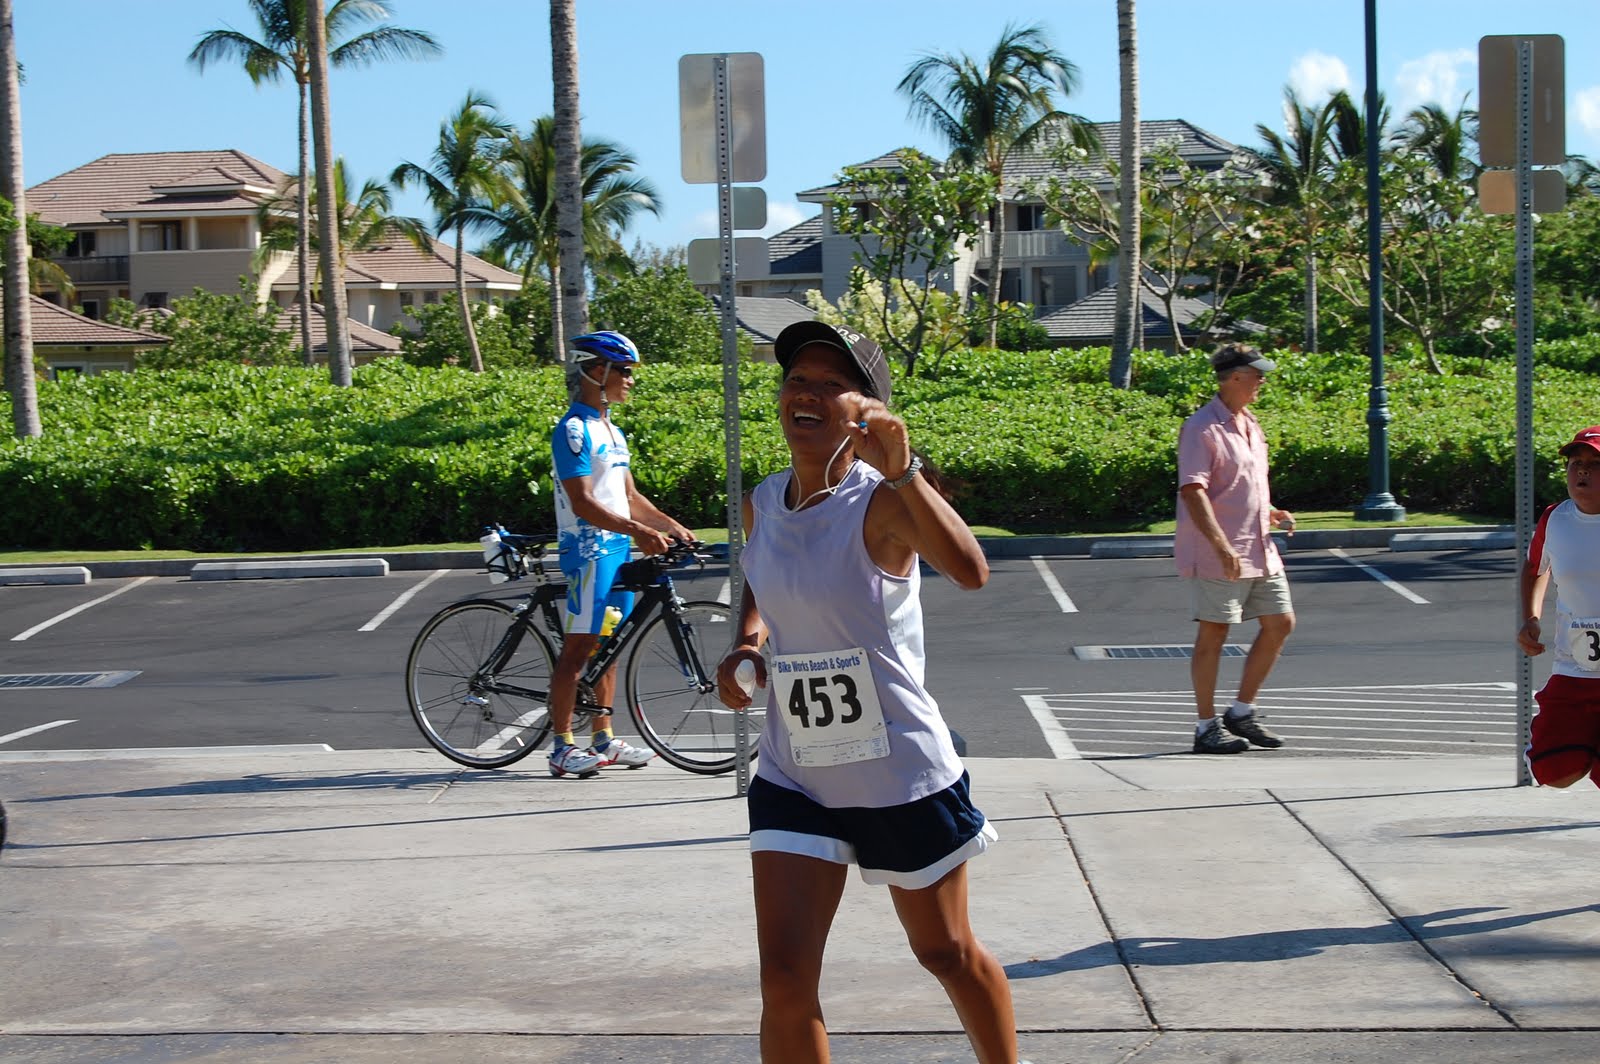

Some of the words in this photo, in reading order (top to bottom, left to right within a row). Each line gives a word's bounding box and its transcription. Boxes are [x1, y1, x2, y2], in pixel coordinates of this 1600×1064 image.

[778, 661, 792, 673] Bike
[791, 661, 809, 672] Works
[809, 659, 829, 671] Beach
[829, 657, 836, 669] &
[836, 655, 860, 670] Sports
[789, 674, 862, 728] 453
